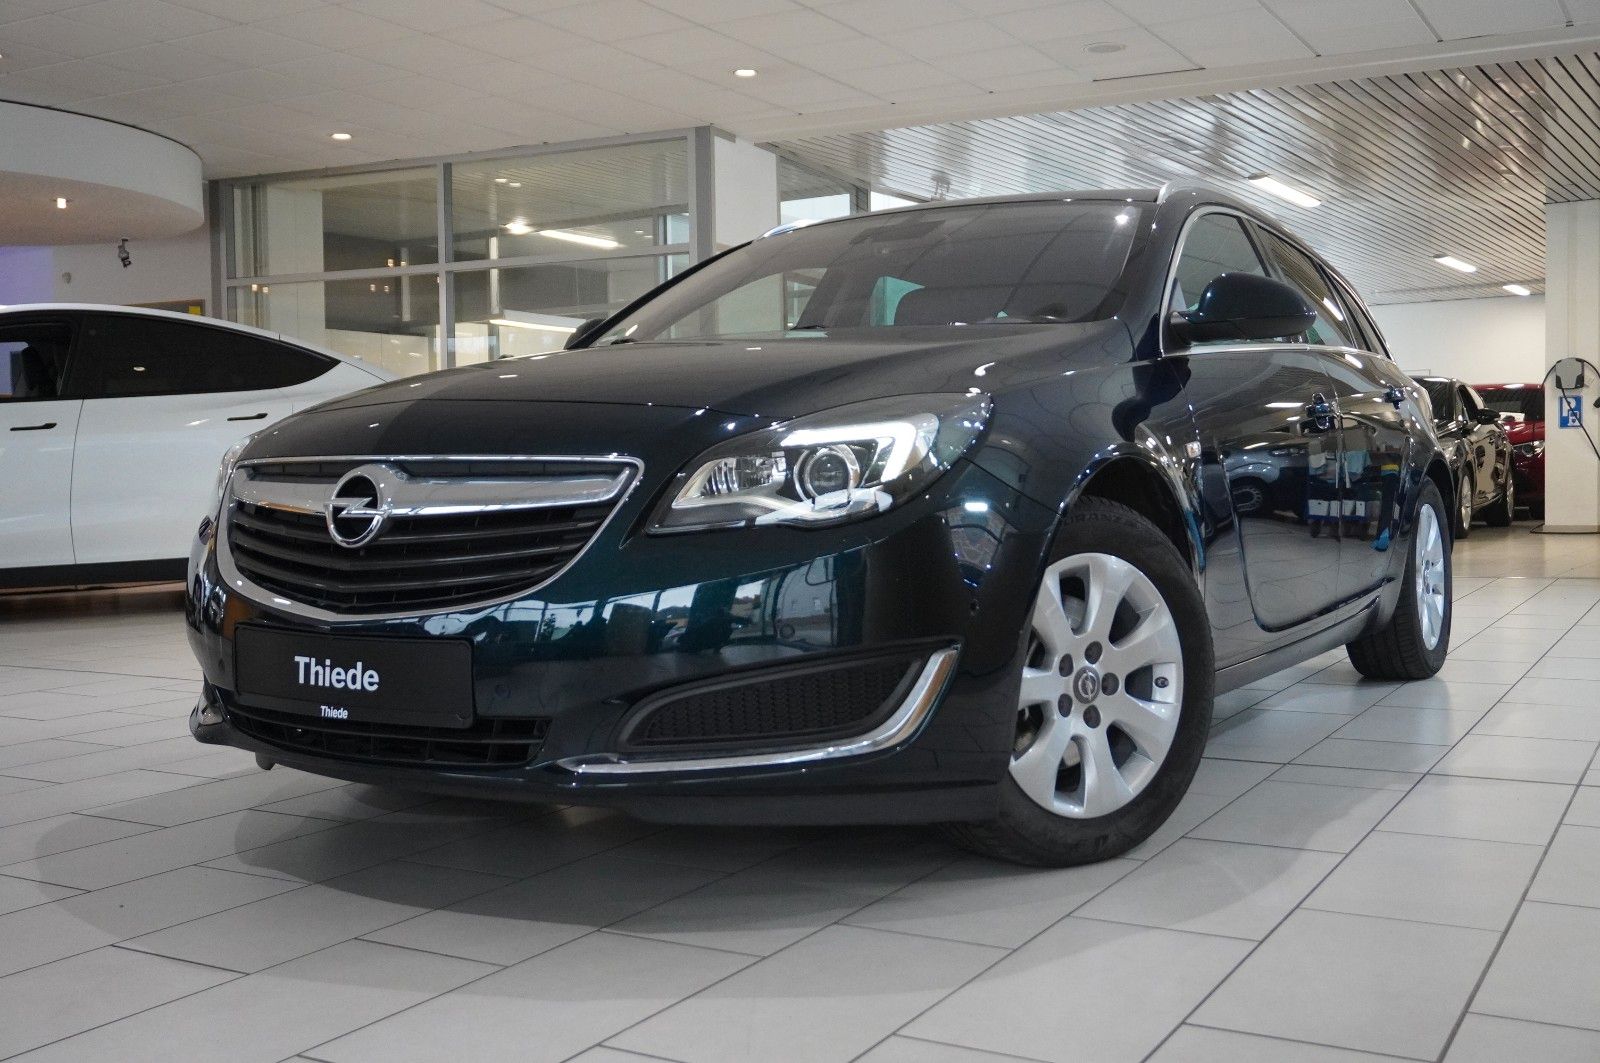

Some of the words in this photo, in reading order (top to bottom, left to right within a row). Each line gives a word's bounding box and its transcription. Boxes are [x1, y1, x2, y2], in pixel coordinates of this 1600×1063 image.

[1562, 397, 1577, 417] P
[294, 655, 380, 692] Thiede
[320, 705, 348, 719] Thiede
